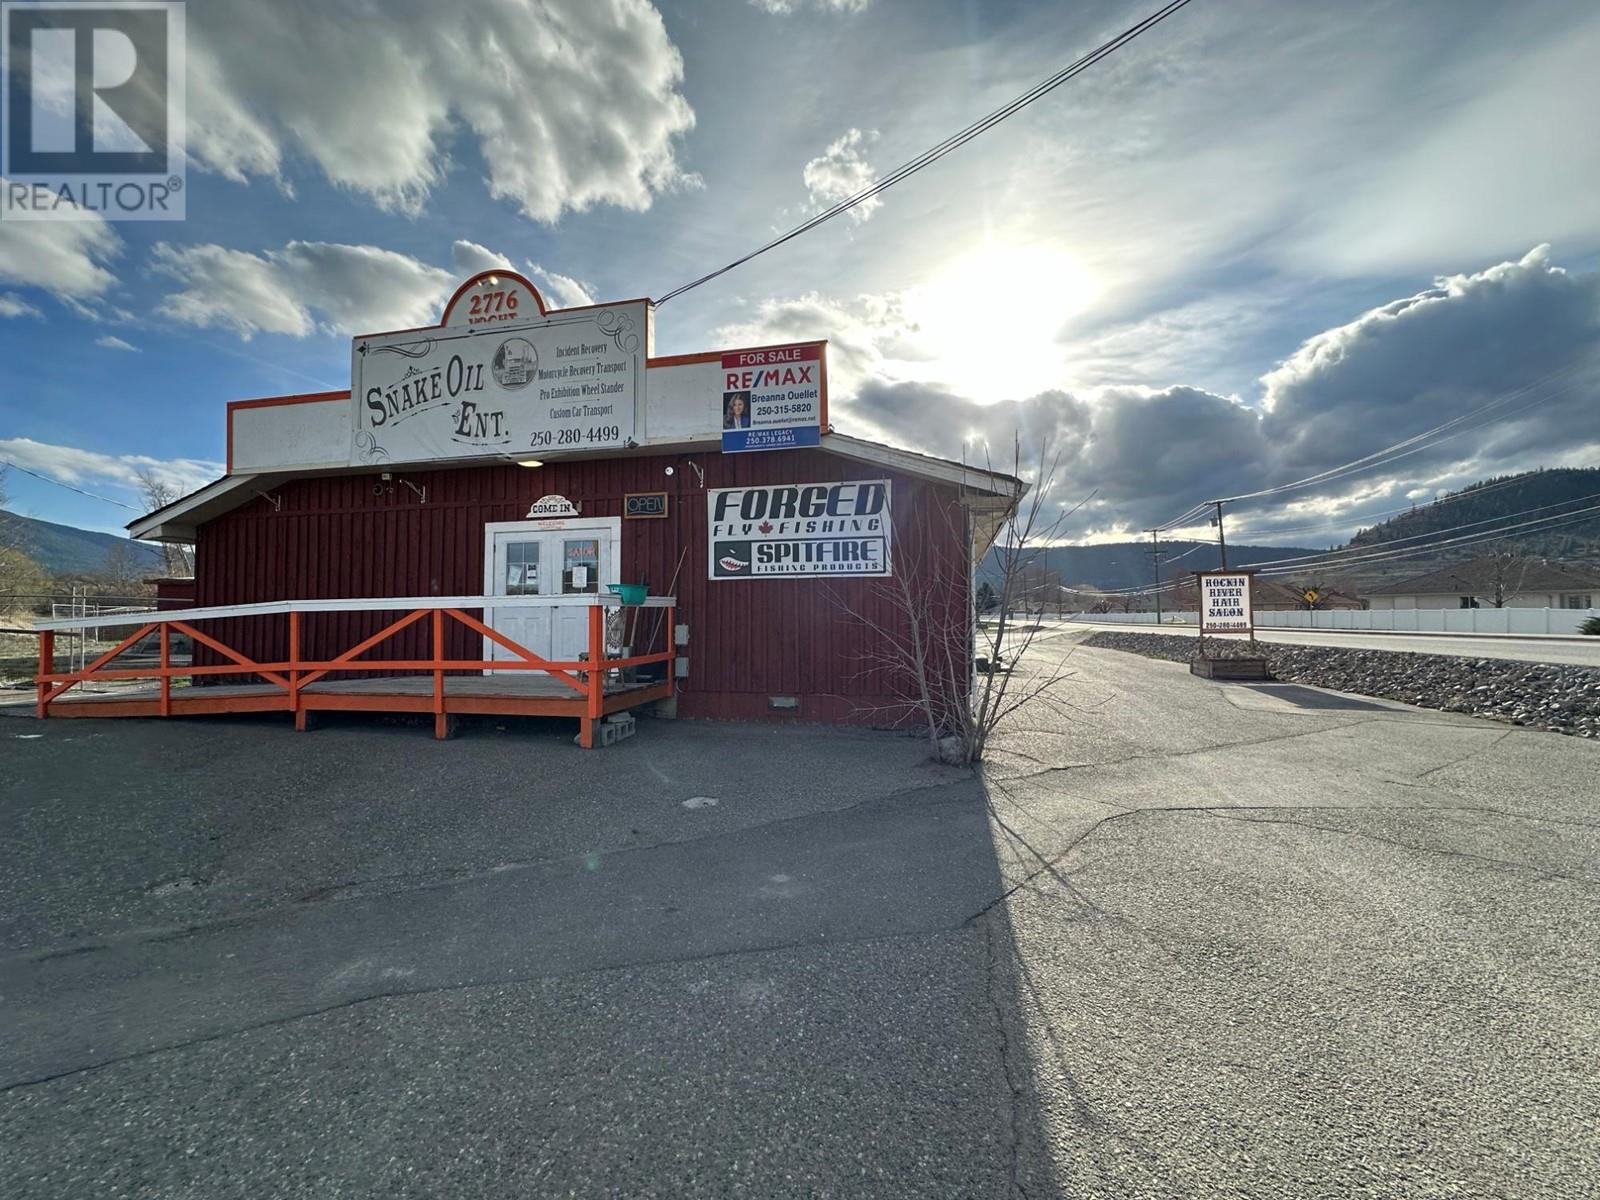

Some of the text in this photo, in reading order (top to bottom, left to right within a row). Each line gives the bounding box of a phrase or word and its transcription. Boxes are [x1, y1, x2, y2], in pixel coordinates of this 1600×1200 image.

[469, 289, 518, 315] 2776
[556, 343, 608, 358] Incident Recovery
[740, 349, 801, 365] FOR SALE
[538, 361, 627, 380] Motorcycle Recovery Transport
[726, 366, 812, 390] RE/MAX
[366, 354, 485, 427] SNAKE OIL
[540, 381, 624, 400] Pro Exhibition Wheel Stander
[751, 389, 818, 403] Breanna Ouellet
[550, 404, 613, 419] Custom Car Transport
[757, 403, 812, 415] 250-315-5820
[455, 400, 510, 438] ENT.
[530, 425, 619, 446] 250-280-4499
[533, 503, 571, 513] COME IN
[628, 497, 664, 511] OPEN
[713, 483, 886, 521] FORGED
[713, 518, 880, 537] FLY FISHING
[757, 540, 878, 564] SPITFIRE
[757, 562, 878, 572] FISHING PRODUCTS
[1205, 578, 1245, 587] ROCKIN
[1209, 588, 1242, 597] RIVER
[1212, 598, 1240, 607] HAIR
[1209, 608, 1244, 617] SALON
